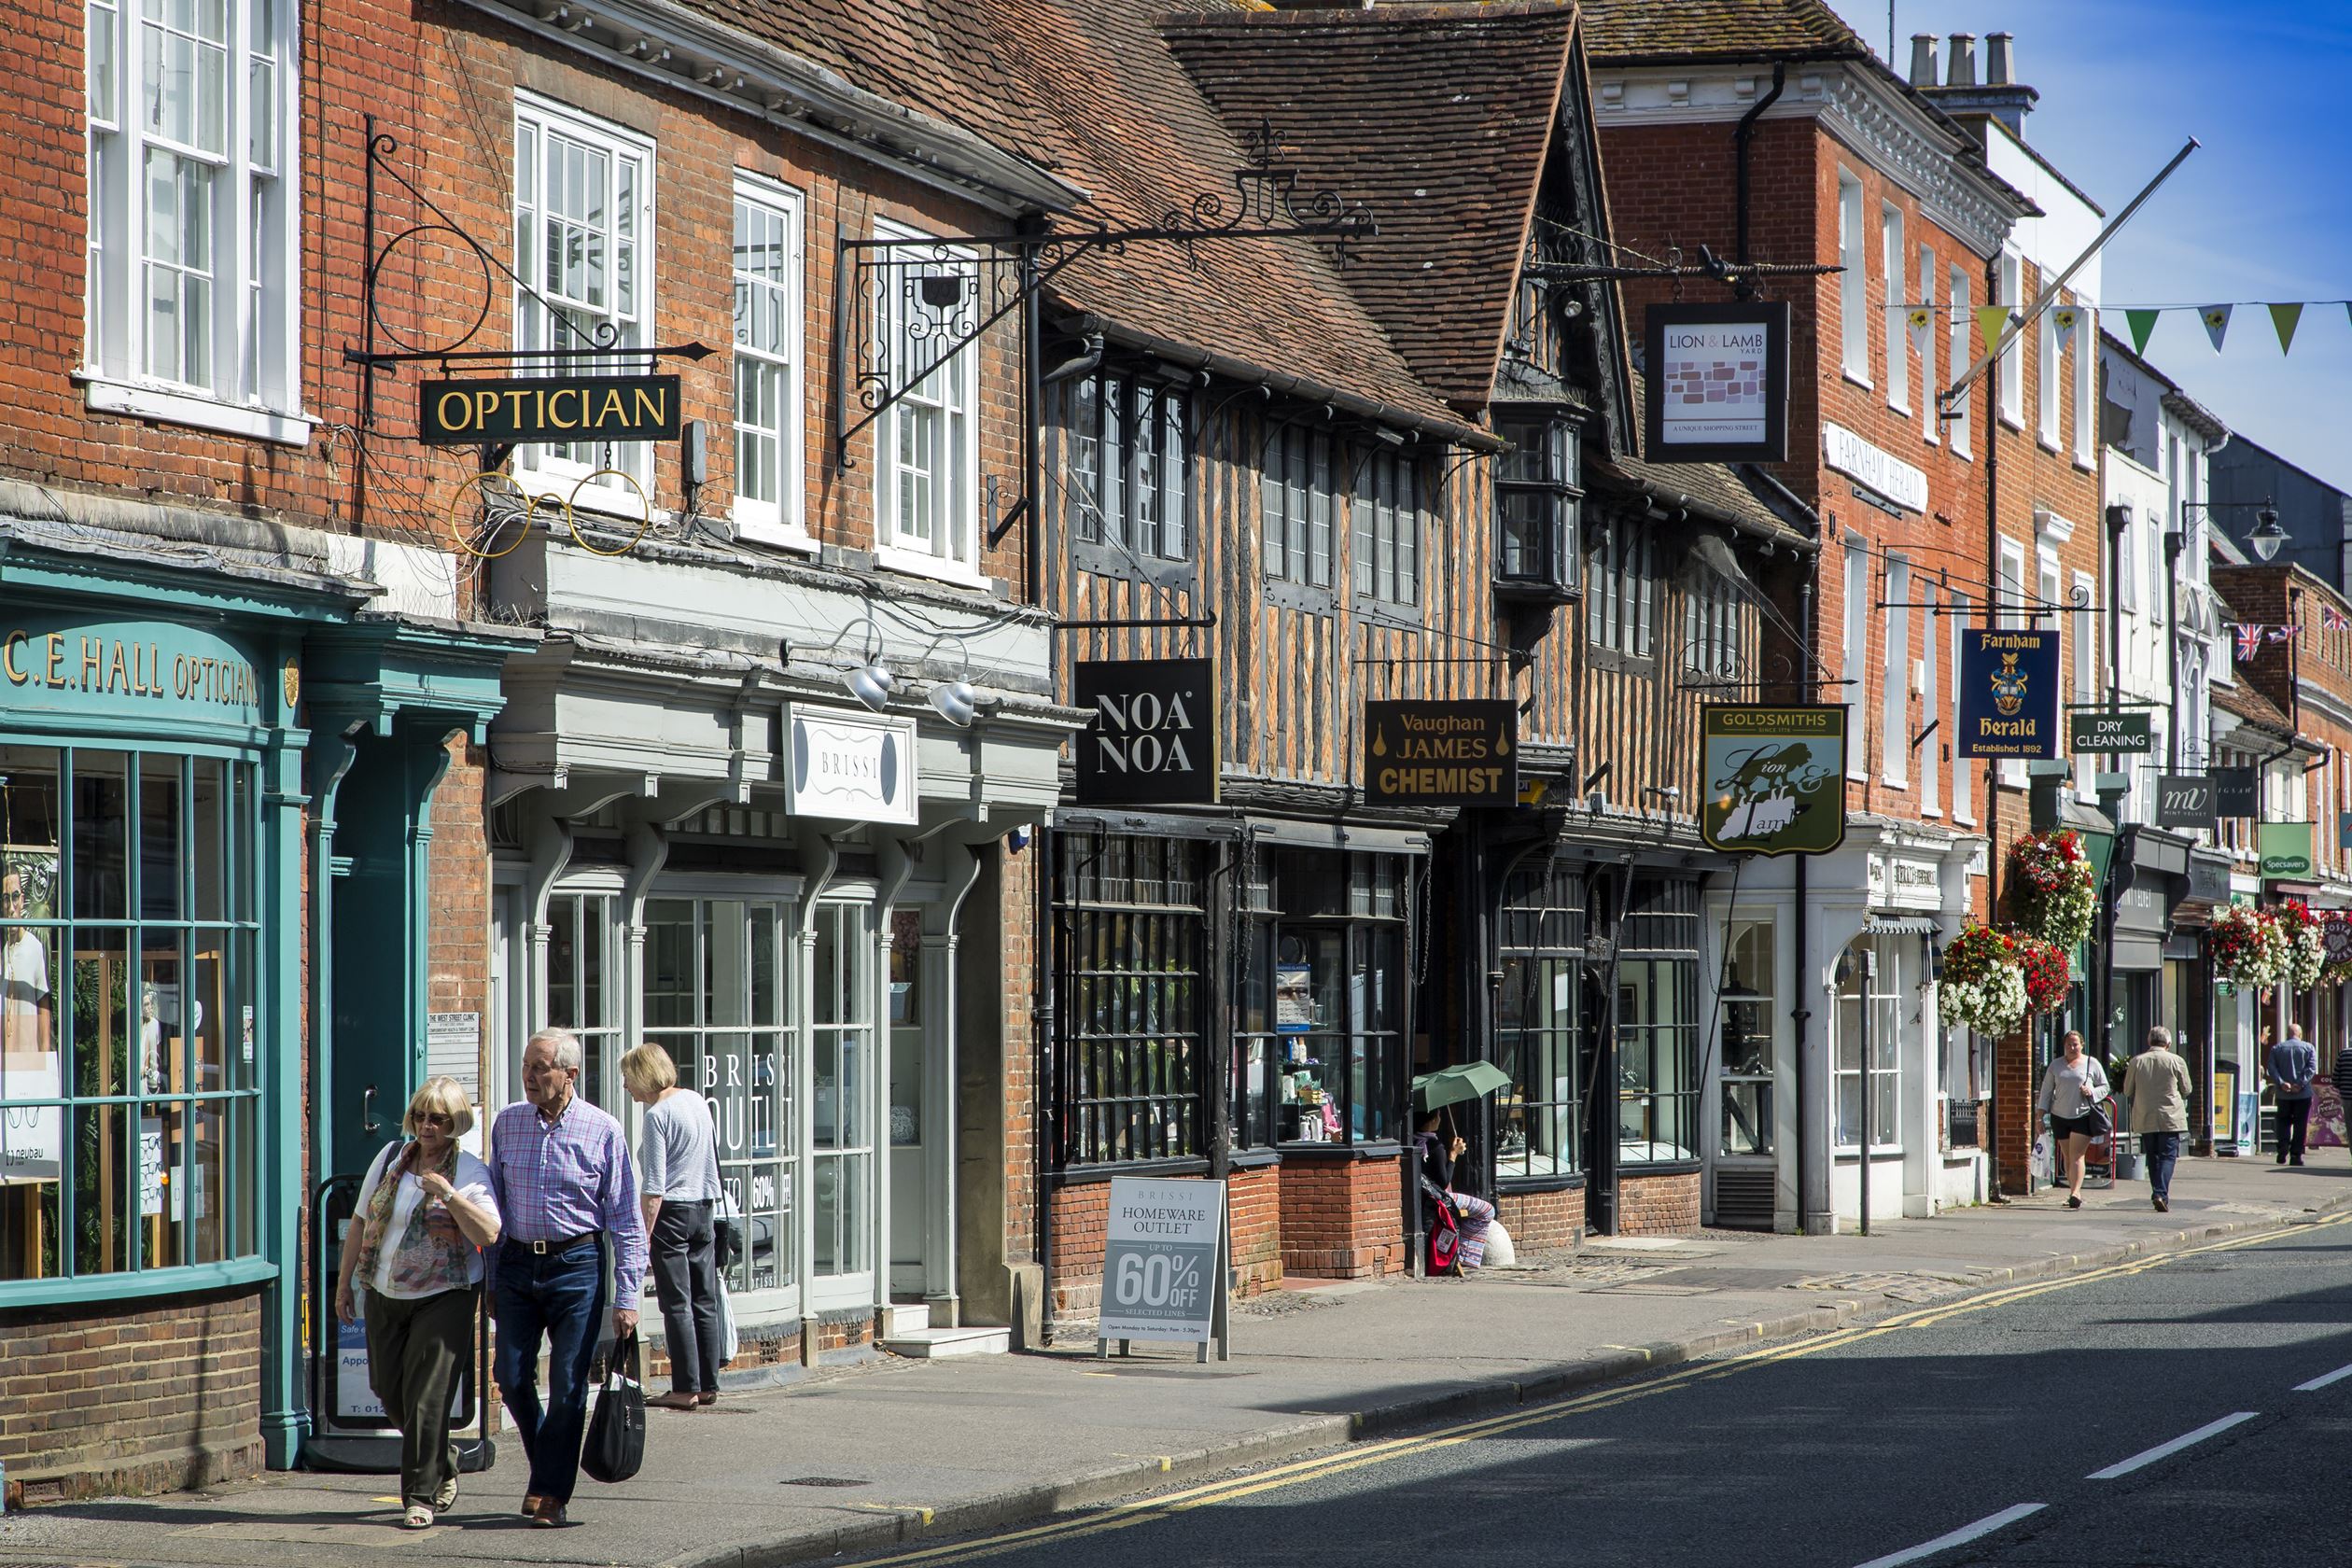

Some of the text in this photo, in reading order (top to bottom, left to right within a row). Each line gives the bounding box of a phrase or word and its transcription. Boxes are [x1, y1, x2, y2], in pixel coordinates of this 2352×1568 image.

[1670, 334, 1762, 348] LION & LAMB
[437, 388, 665, 431] OPTICIAN
[1839, 430, 1920, 506] FARNHAM HERALD
[1981, 633, 2040, 651] Farnham
[173, 652, 260, 707] OPTICIANS
[1096, 692, 1194, 731] NOA
[1722, 713, 1827, 726] GOLDSMITHS
[1401, 714, 1485, 735] Vaughan
[2097, 721, 2124, 732] DRY
[1396, 738, 1488, 759] JAMES
[1972, 743, 2042, 753] Established 1892
[2077, 735, 2146, 747] CLEANING
[1097, 734, 1194, 773] NOA
[821, 751, 876, 778] BRISSI
[1715, 743, 1787, 791] Lion
[1379, 767, 1503, 794] CHEMIST
[2266, 860, 2305, 869] Specsavers
[16, 1147, 43, 1159] neubau
[724, 1177, 741, 1209] TO
[752, 1175, 774, 1208] 60%
[1138, 1190, 1193, 1200] BRISSI
[1123, 1207, 1206, 1221] HOMEWARE
[1134, 1221, 1193, 1234] OUTLET
[1169, 1288, 1198, 1307] OFF
[341, 1324, 359, 1334] Safe
[342, 1356, 368, 1367] Appo
